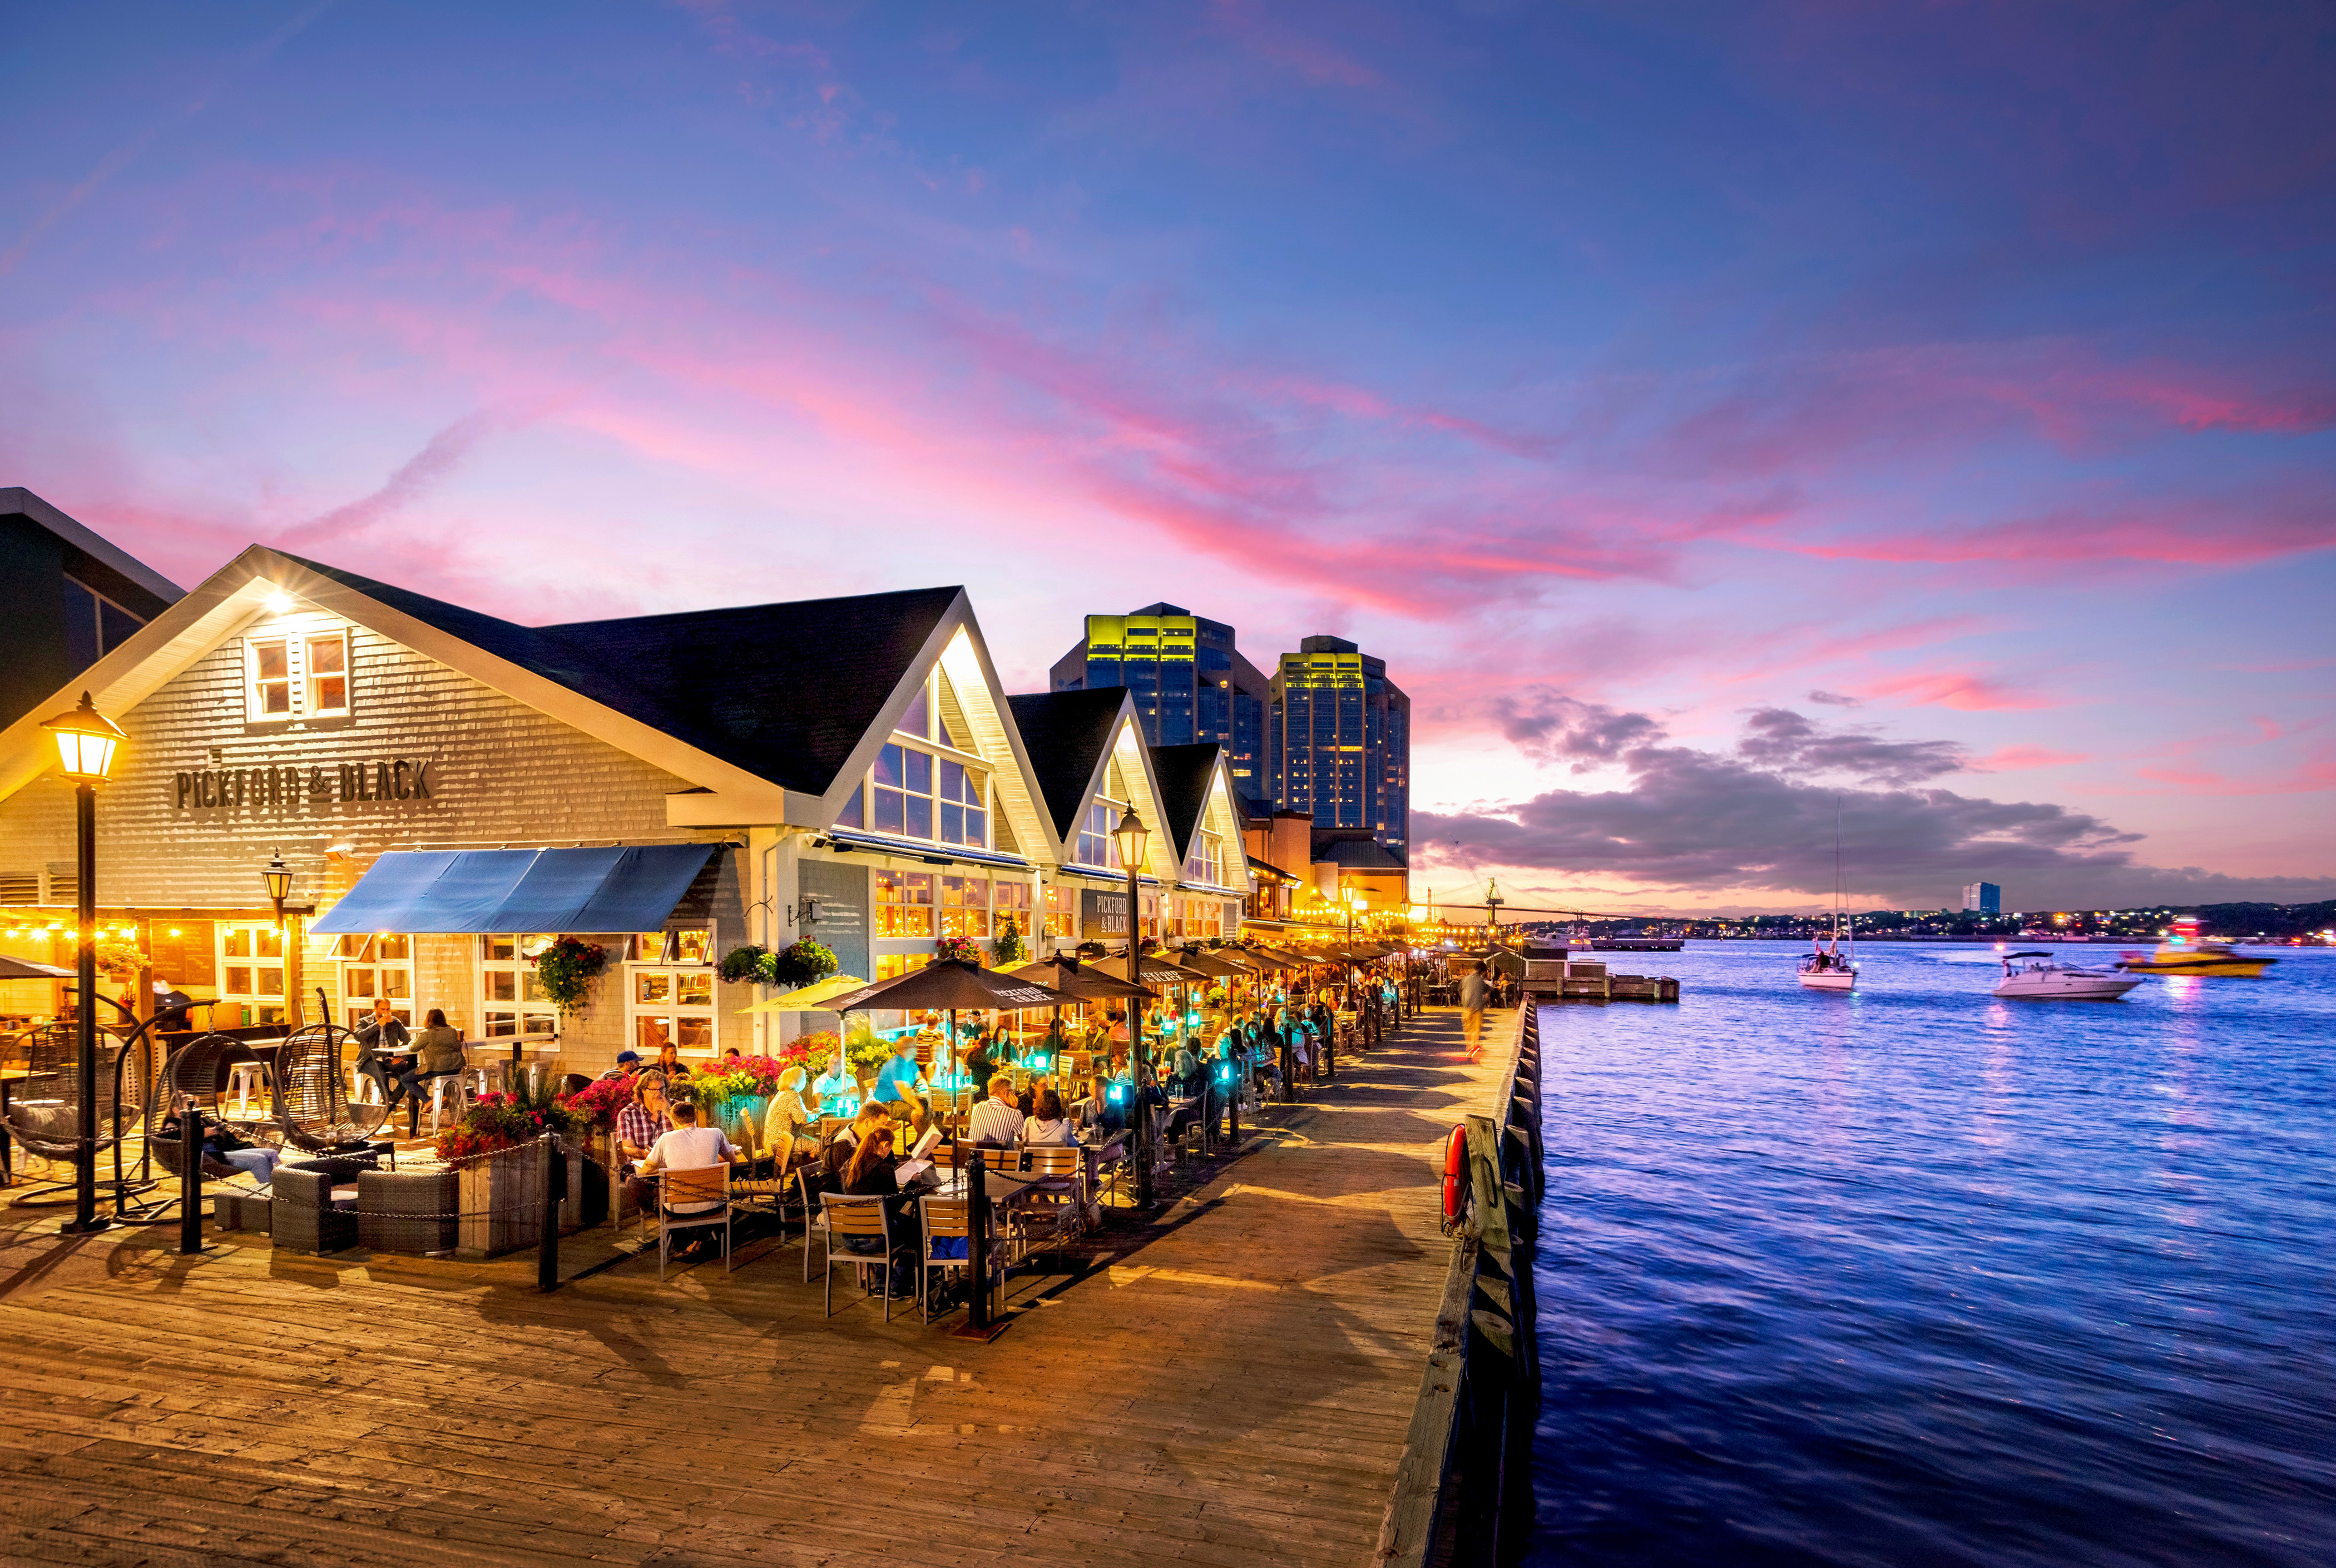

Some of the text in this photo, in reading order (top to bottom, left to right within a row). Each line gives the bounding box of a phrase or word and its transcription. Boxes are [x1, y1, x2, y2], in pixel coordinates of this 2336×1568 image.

[176, 760, 430, 809] PICKFORD & BLACK
[1097, 895, 1127, 914] PICKFORD
[991, 986, 1042, 997] PICKFORD
